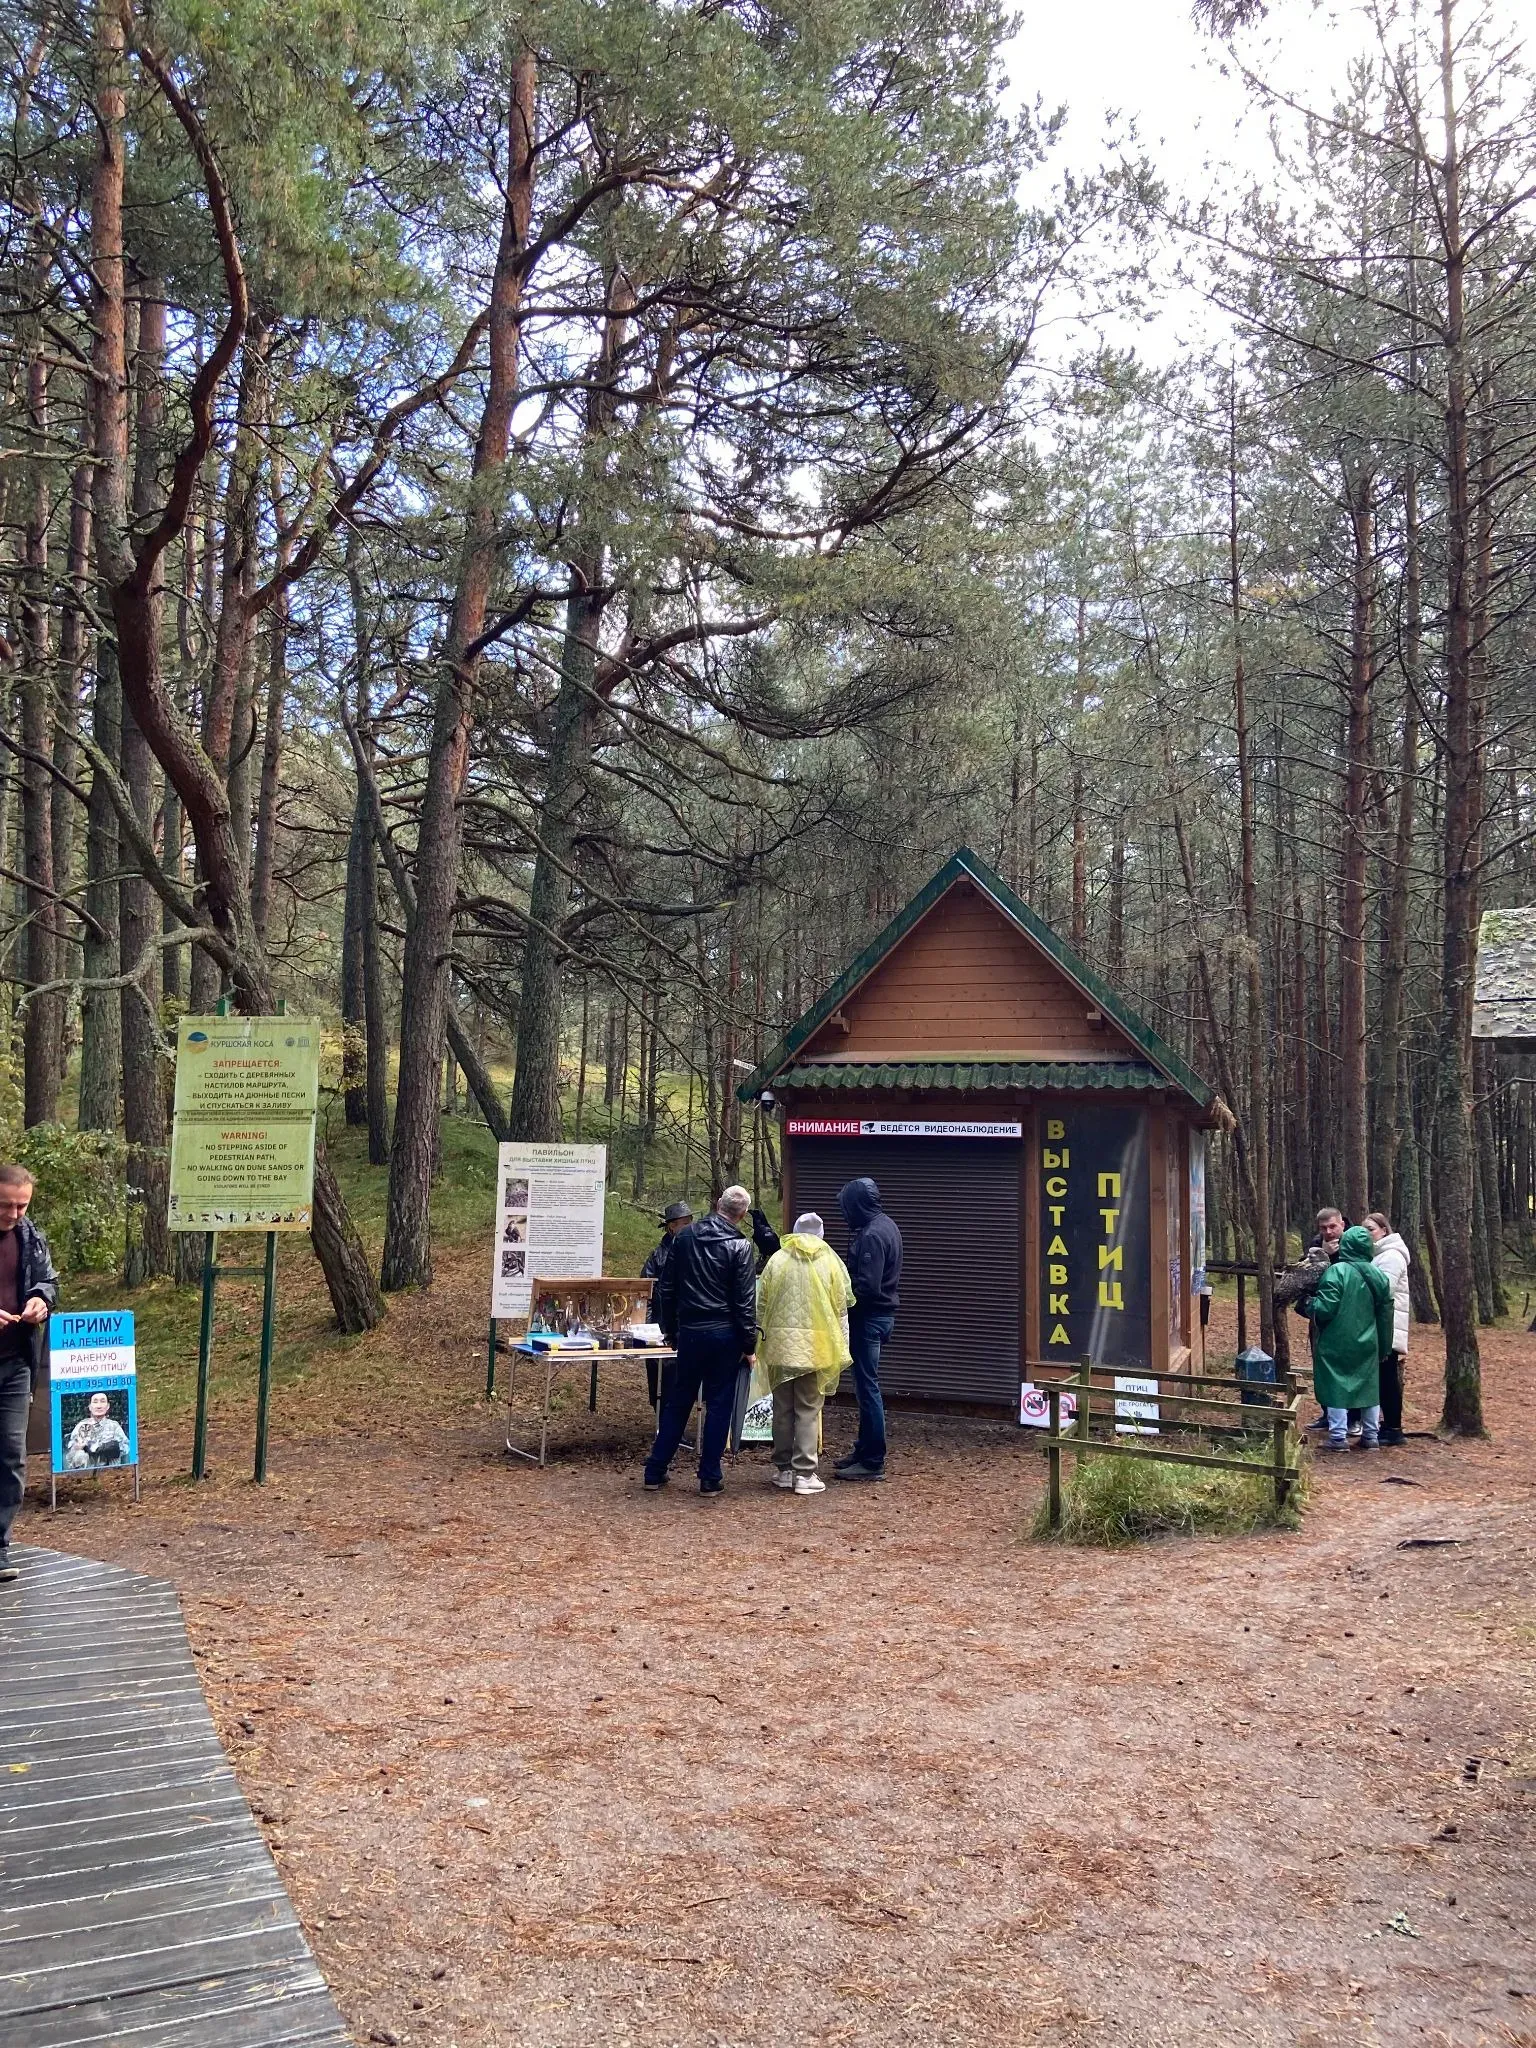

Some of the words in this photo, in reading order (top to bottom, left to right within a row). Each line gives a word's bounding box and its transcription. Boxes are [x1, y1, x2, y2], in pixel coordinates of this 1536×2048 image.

[789, 1122, 858, 1132] ВНИМАНИЕ
[924, 1125, 1018, 1134] ВИДЕОНАБЛЮДЕНИЕ
[1043, 1120, 1072, 1345] ВЫСТАВКА
[1097, 1172, 1124, 1311] ПТИЦ
[63, 1316, 123, 1334] ПРИМУ
[62, 1339, 76, 1348] НА
[79, 1336, 124, 1347] ЛЕЧЕНИЕ
[70, 1352, 116, 1363] РАНЕНУЮ
[101, 1363, 127, 1372] ПТИЦУ
[65, 1380, 81, 1389] 911
[106, 1378, 117, 1386] 09
